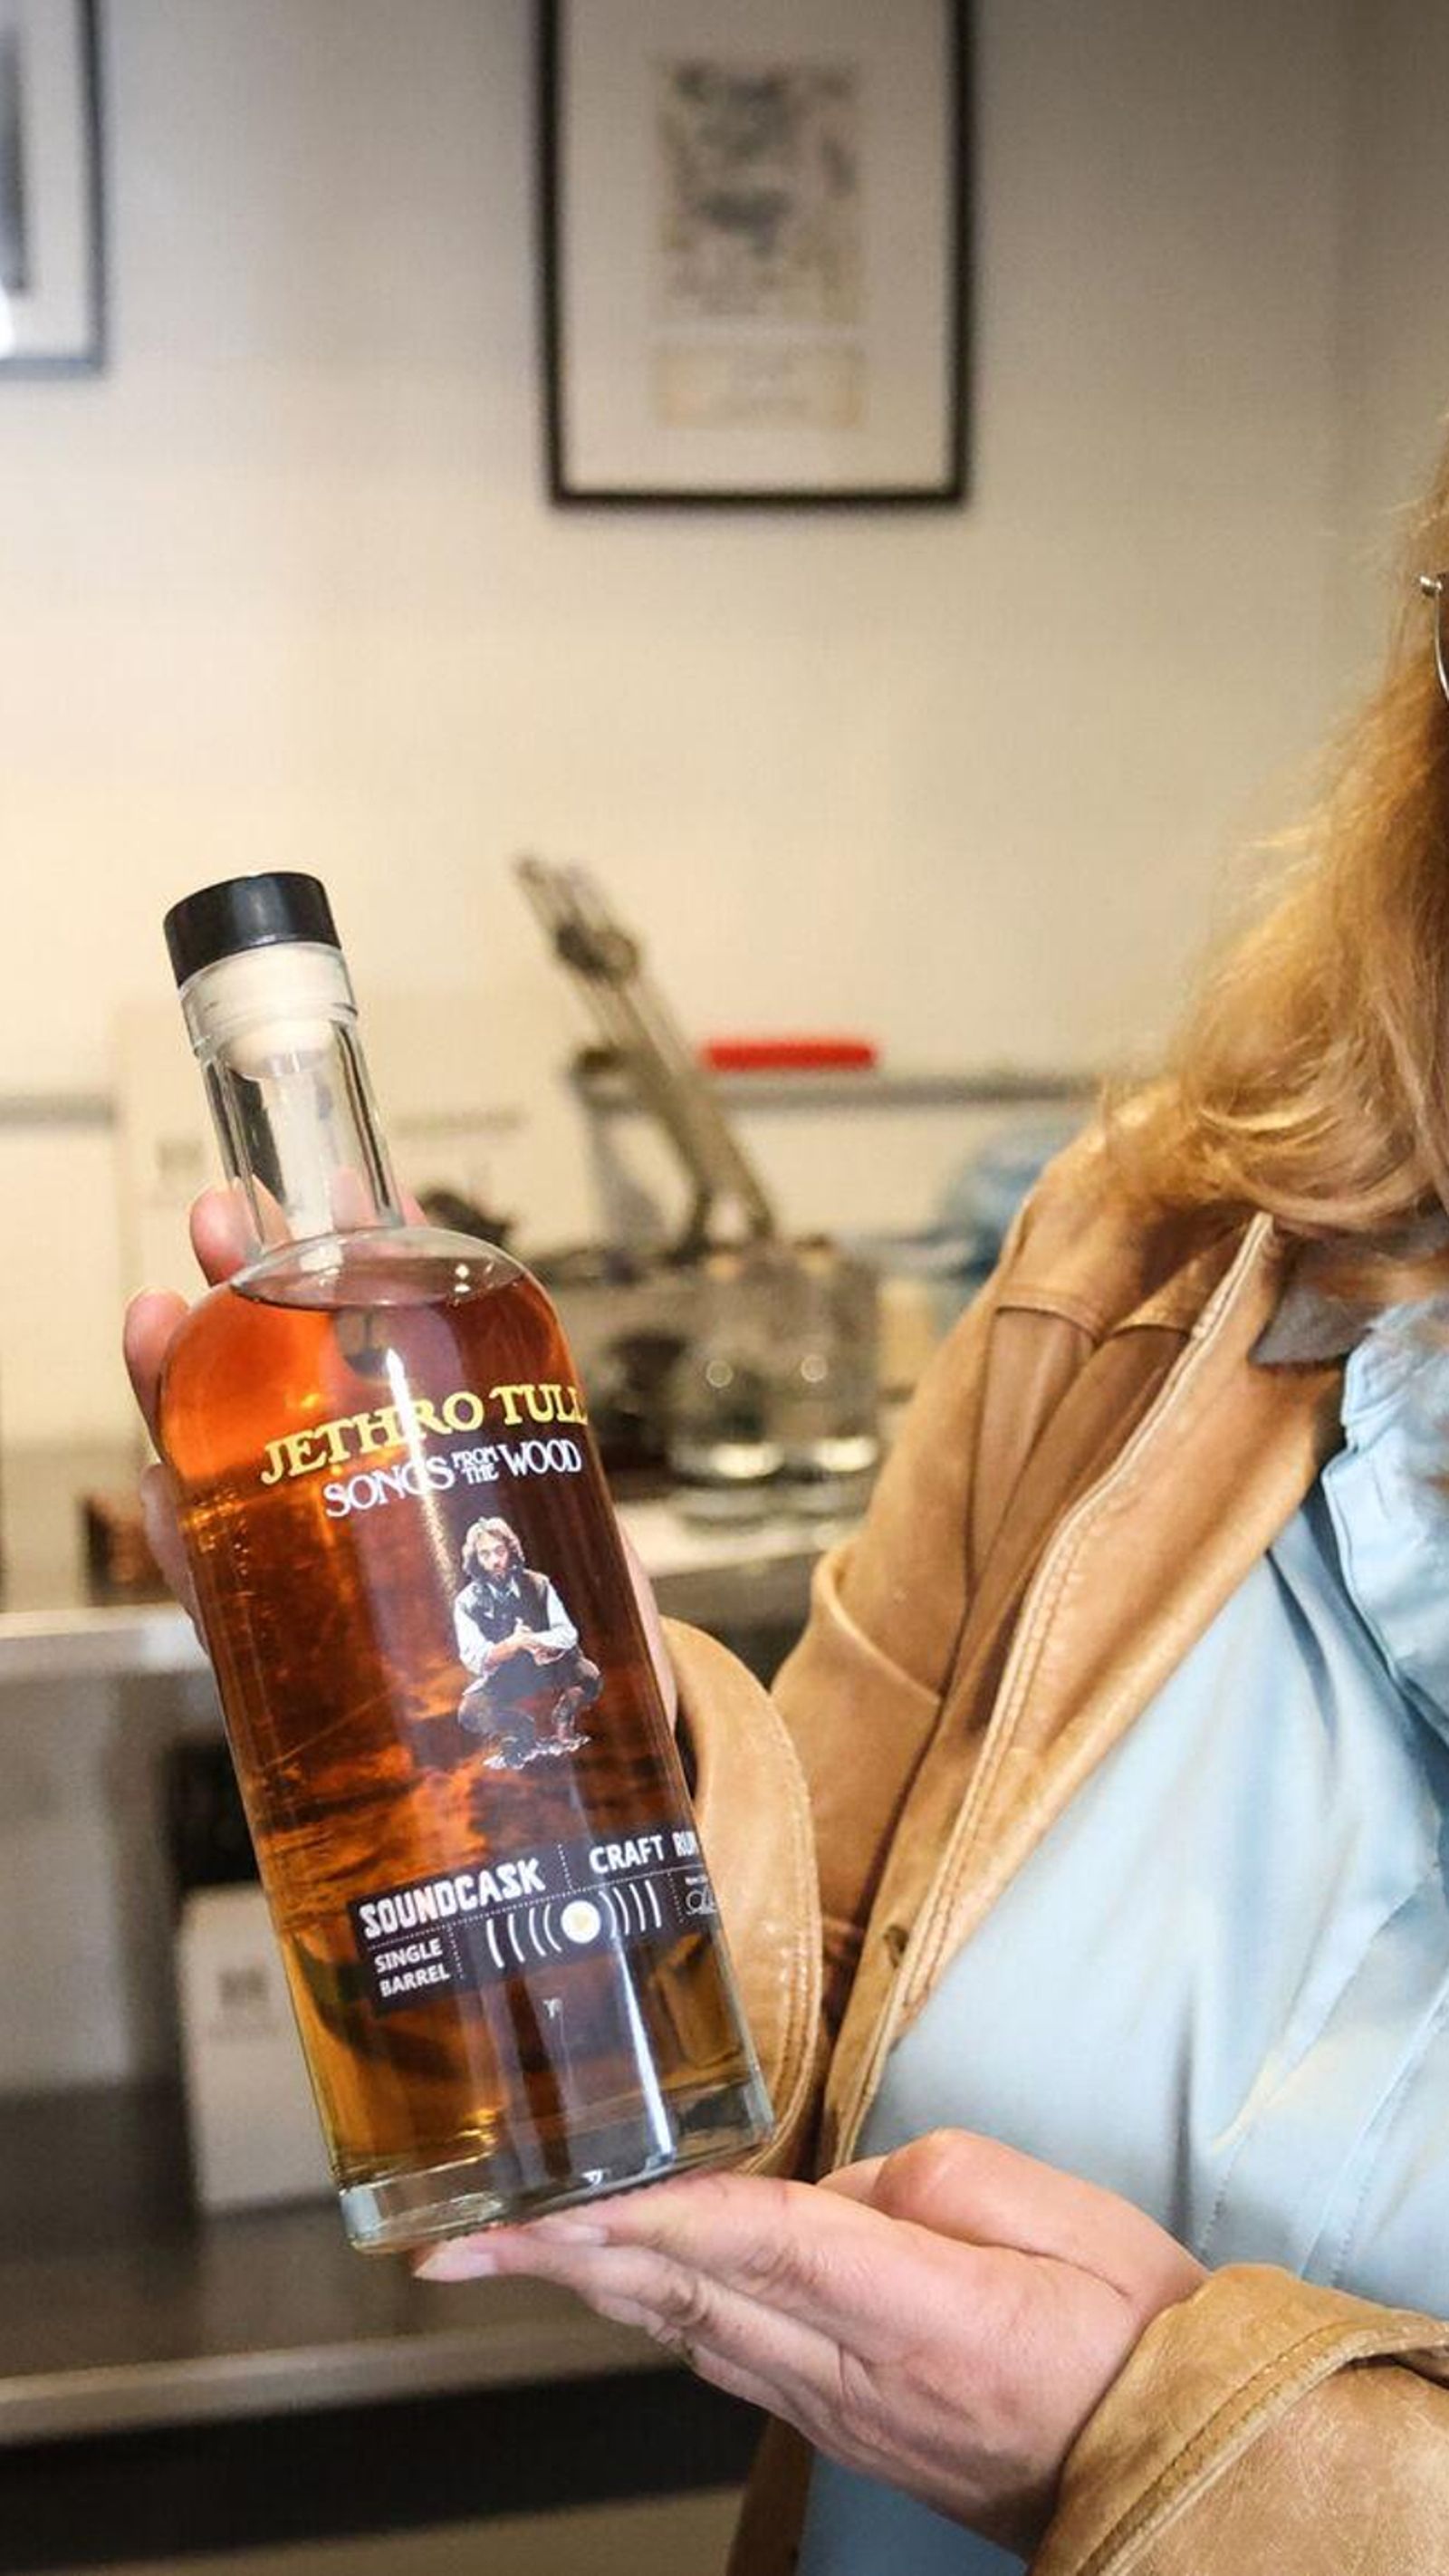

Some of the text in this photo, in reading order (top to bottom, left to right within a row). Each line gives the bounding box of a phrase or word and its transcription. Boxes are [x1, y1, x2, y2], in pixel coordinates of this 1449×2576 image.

[260, 1384, 588, 1485] JETHRO TULL
[323, 1438, 581, 1517] SONGS FROM THE WOOD
[589, 1835, 664, 1874] CRAFT
[359, 1858, 545, 1939] SOUNDCASK
[373, 1938, 443, 1973] SINGLE
[379, 1966, 451, 1998] BARREL
